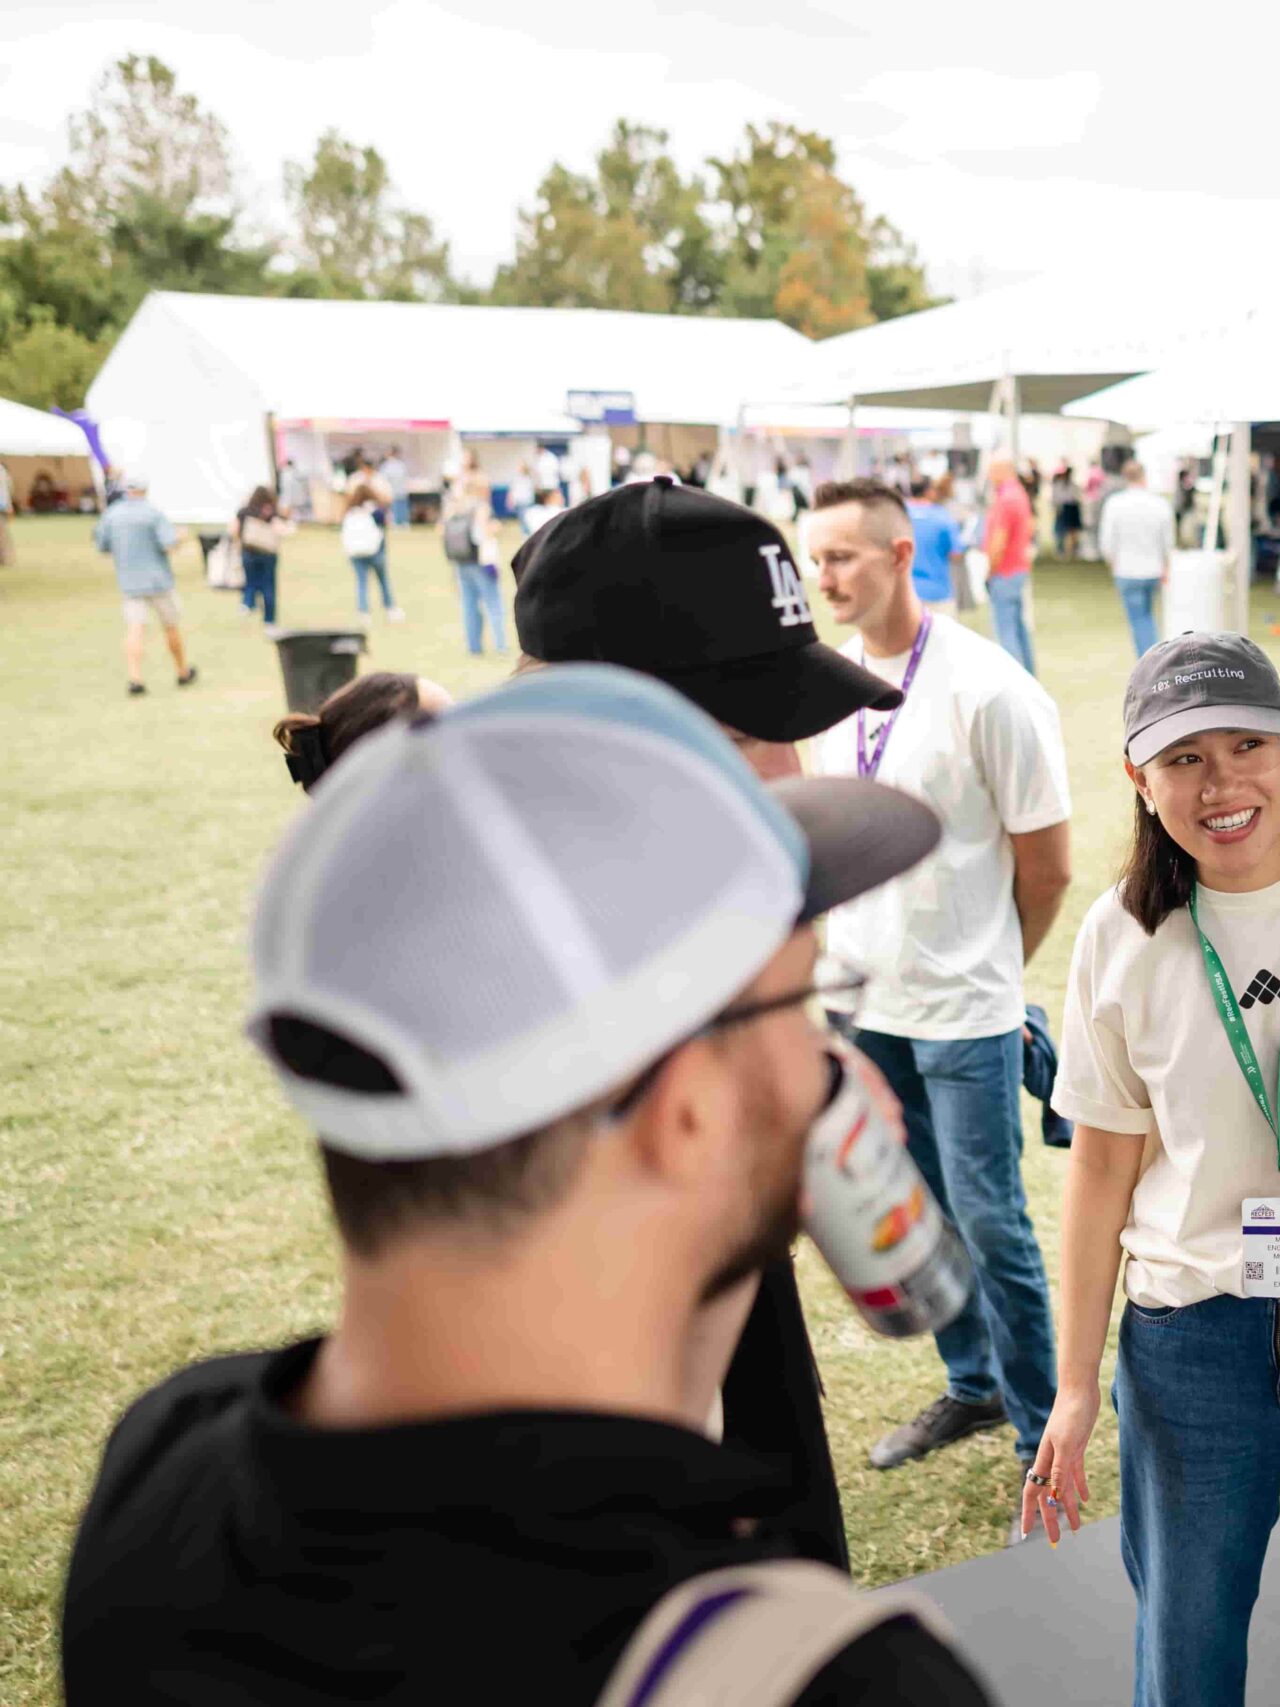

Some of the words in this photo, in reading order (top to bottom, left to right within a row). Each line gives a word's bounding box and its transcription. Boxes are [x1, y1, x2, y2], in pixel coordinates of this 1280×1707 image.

[758, 544, 813, 626] LA
[1151, 679, 1170, 693] 10x
[1174, 667, 1245, 686] Recruiting
[1214, 971, 1237, 1022] #RecFestUSA
